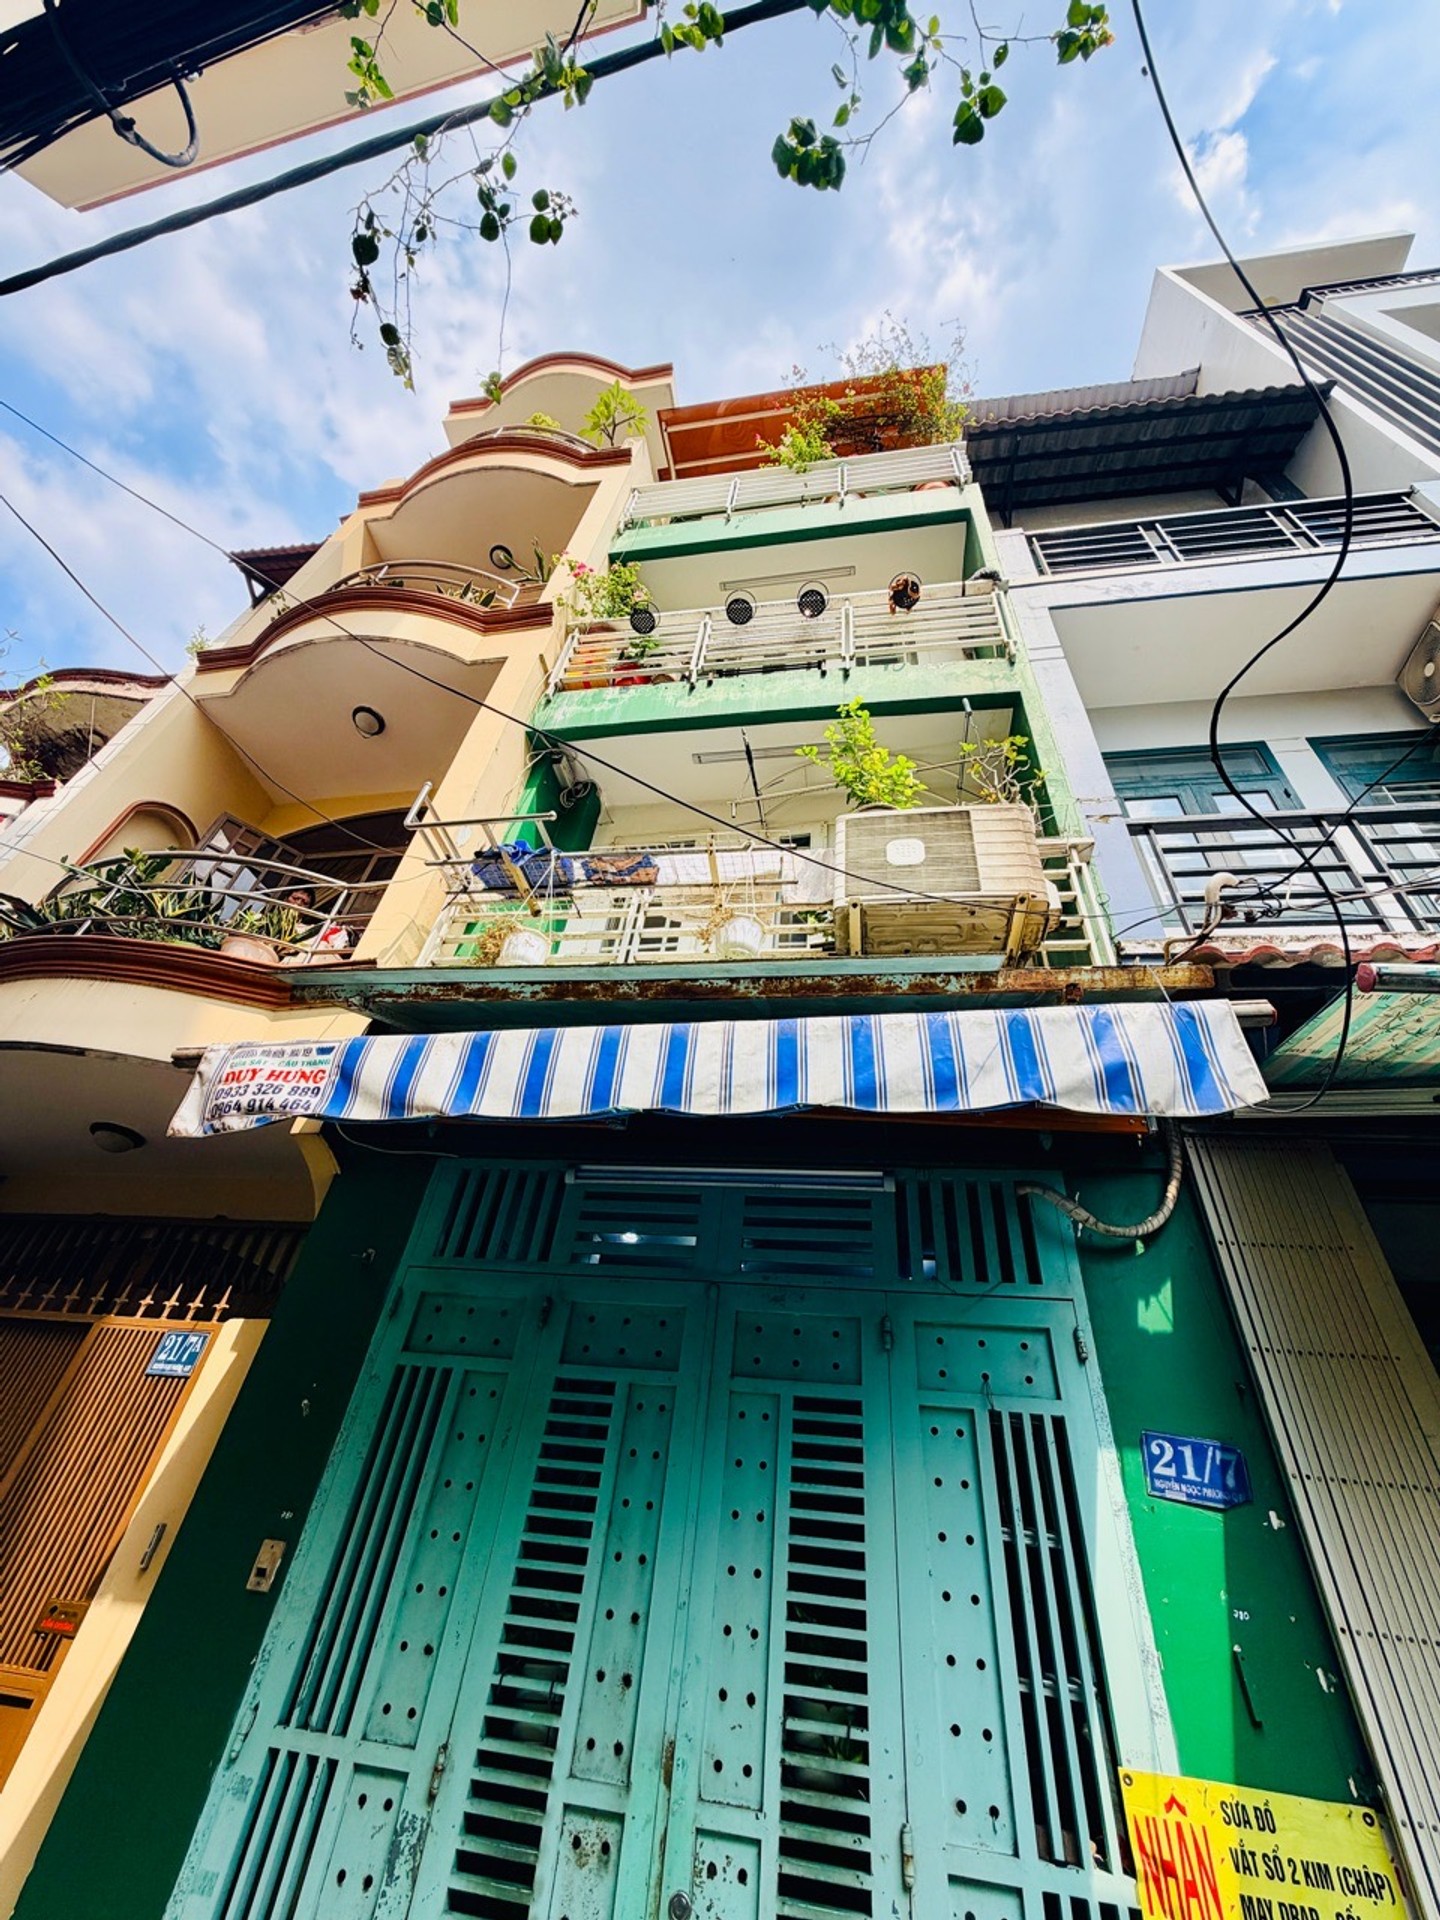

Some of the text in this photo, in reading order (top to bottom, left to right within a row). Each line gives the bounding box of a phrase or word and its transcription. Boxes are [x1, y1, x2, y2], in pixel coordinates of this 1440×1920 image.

[224, 1068, 262, 1084] DUY
[215, 1083, 321, 1101] 0933 326 889
[211, 1097, 312, 1118] 0964 914 464
[158, 1334, 203, 1362] 21/7A
[1150, 1439, 1237, 1487] 21/7
[1181, 1483, 1201, 1497] NGỌC
[1220, 1794, 1277, 1834] SỬA ĐỒ
[1262, 1844, 1285, 1882] SỔ
[1287, 1857, 1301, 1885] 2
[1300, 1859, 1335, 1891] KIM
[1336, 1864, 1396, 1906] (CHẬP)
[1239, 1893, 1275, 1920] MAY
